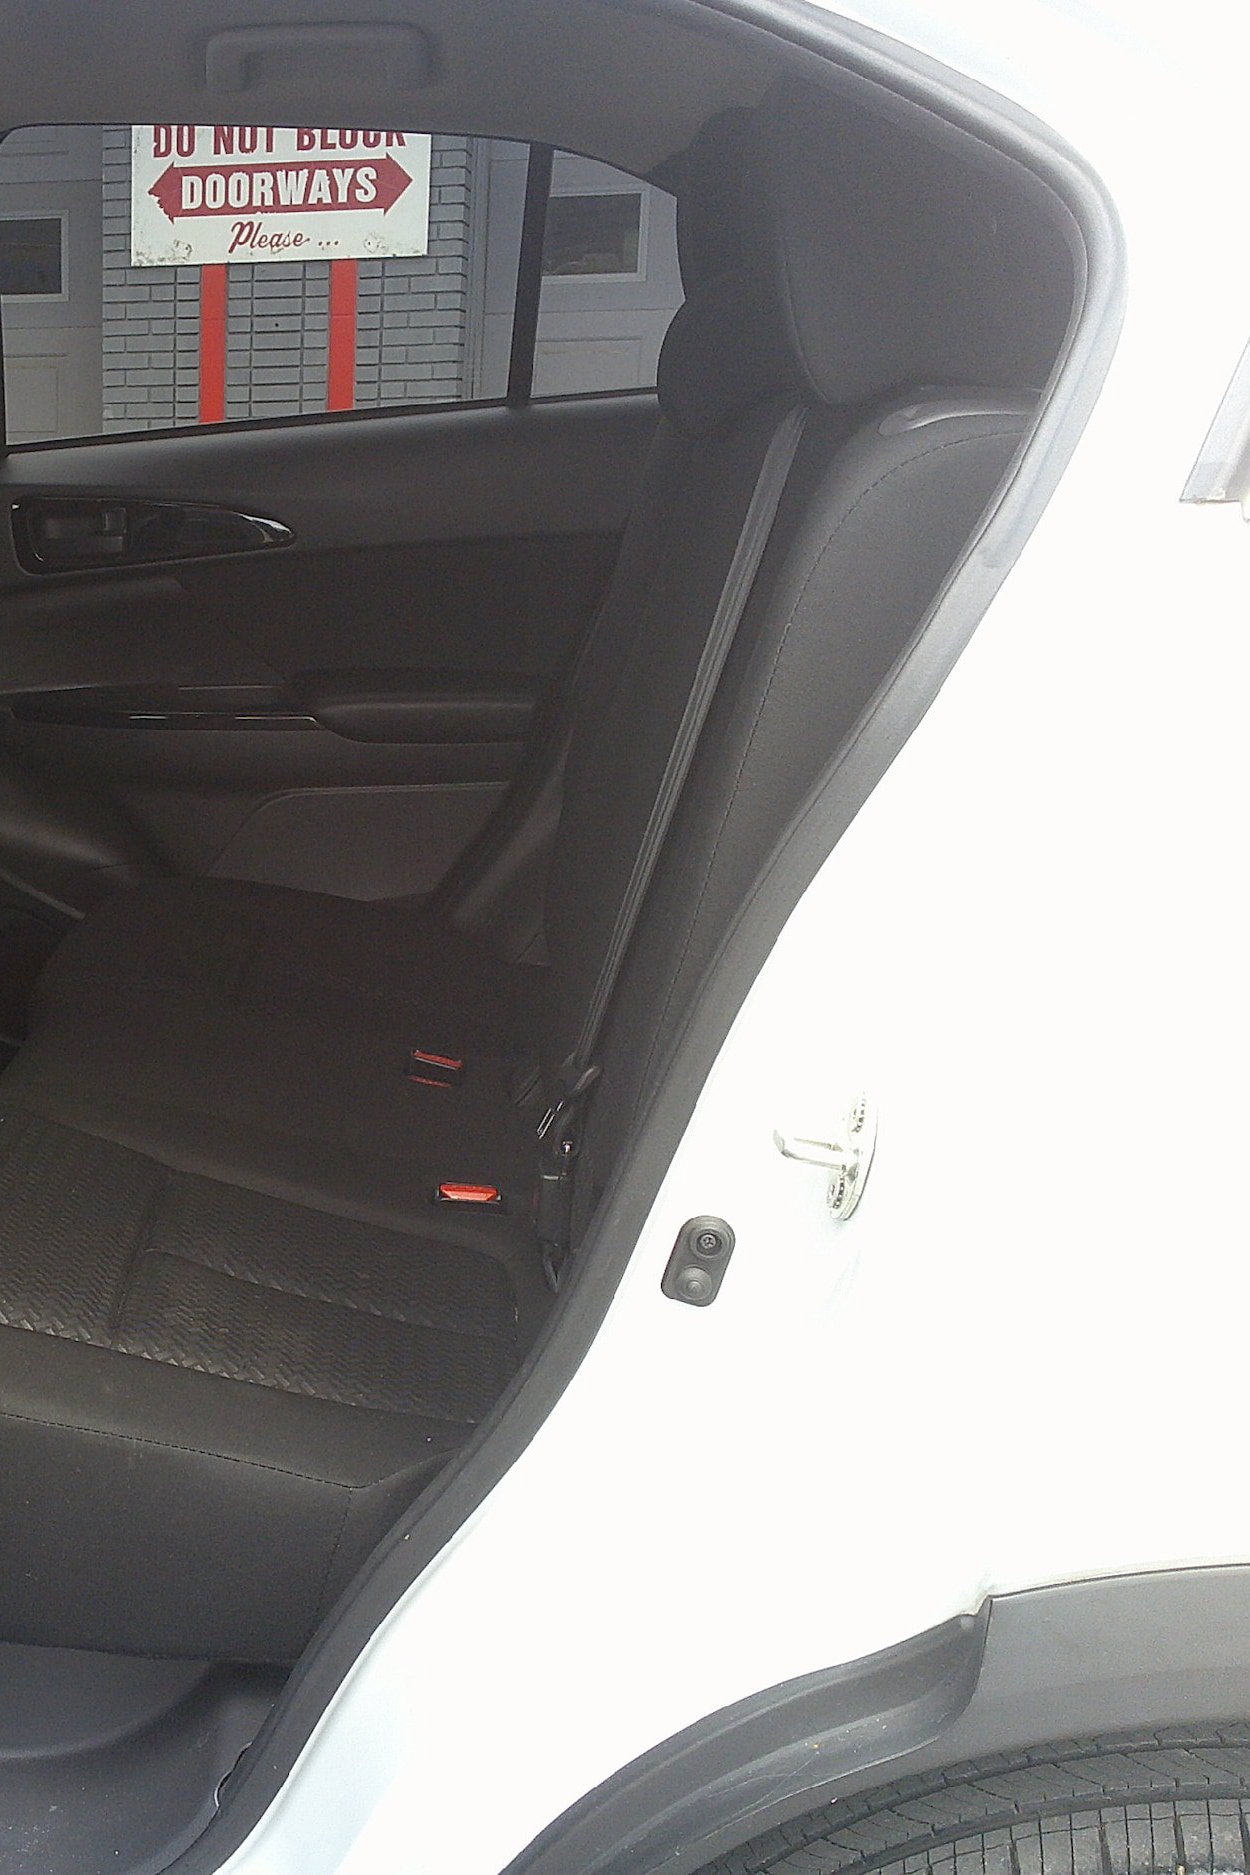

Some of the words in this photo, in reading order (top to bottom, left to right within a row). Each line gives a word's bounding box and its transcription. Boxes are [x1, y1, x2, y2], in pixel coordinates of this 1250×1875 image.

[153, 125, 195, 158] DO
[213, 126, 274, 155] NOT
[182, 167, 377, 210] DOORWAYS
